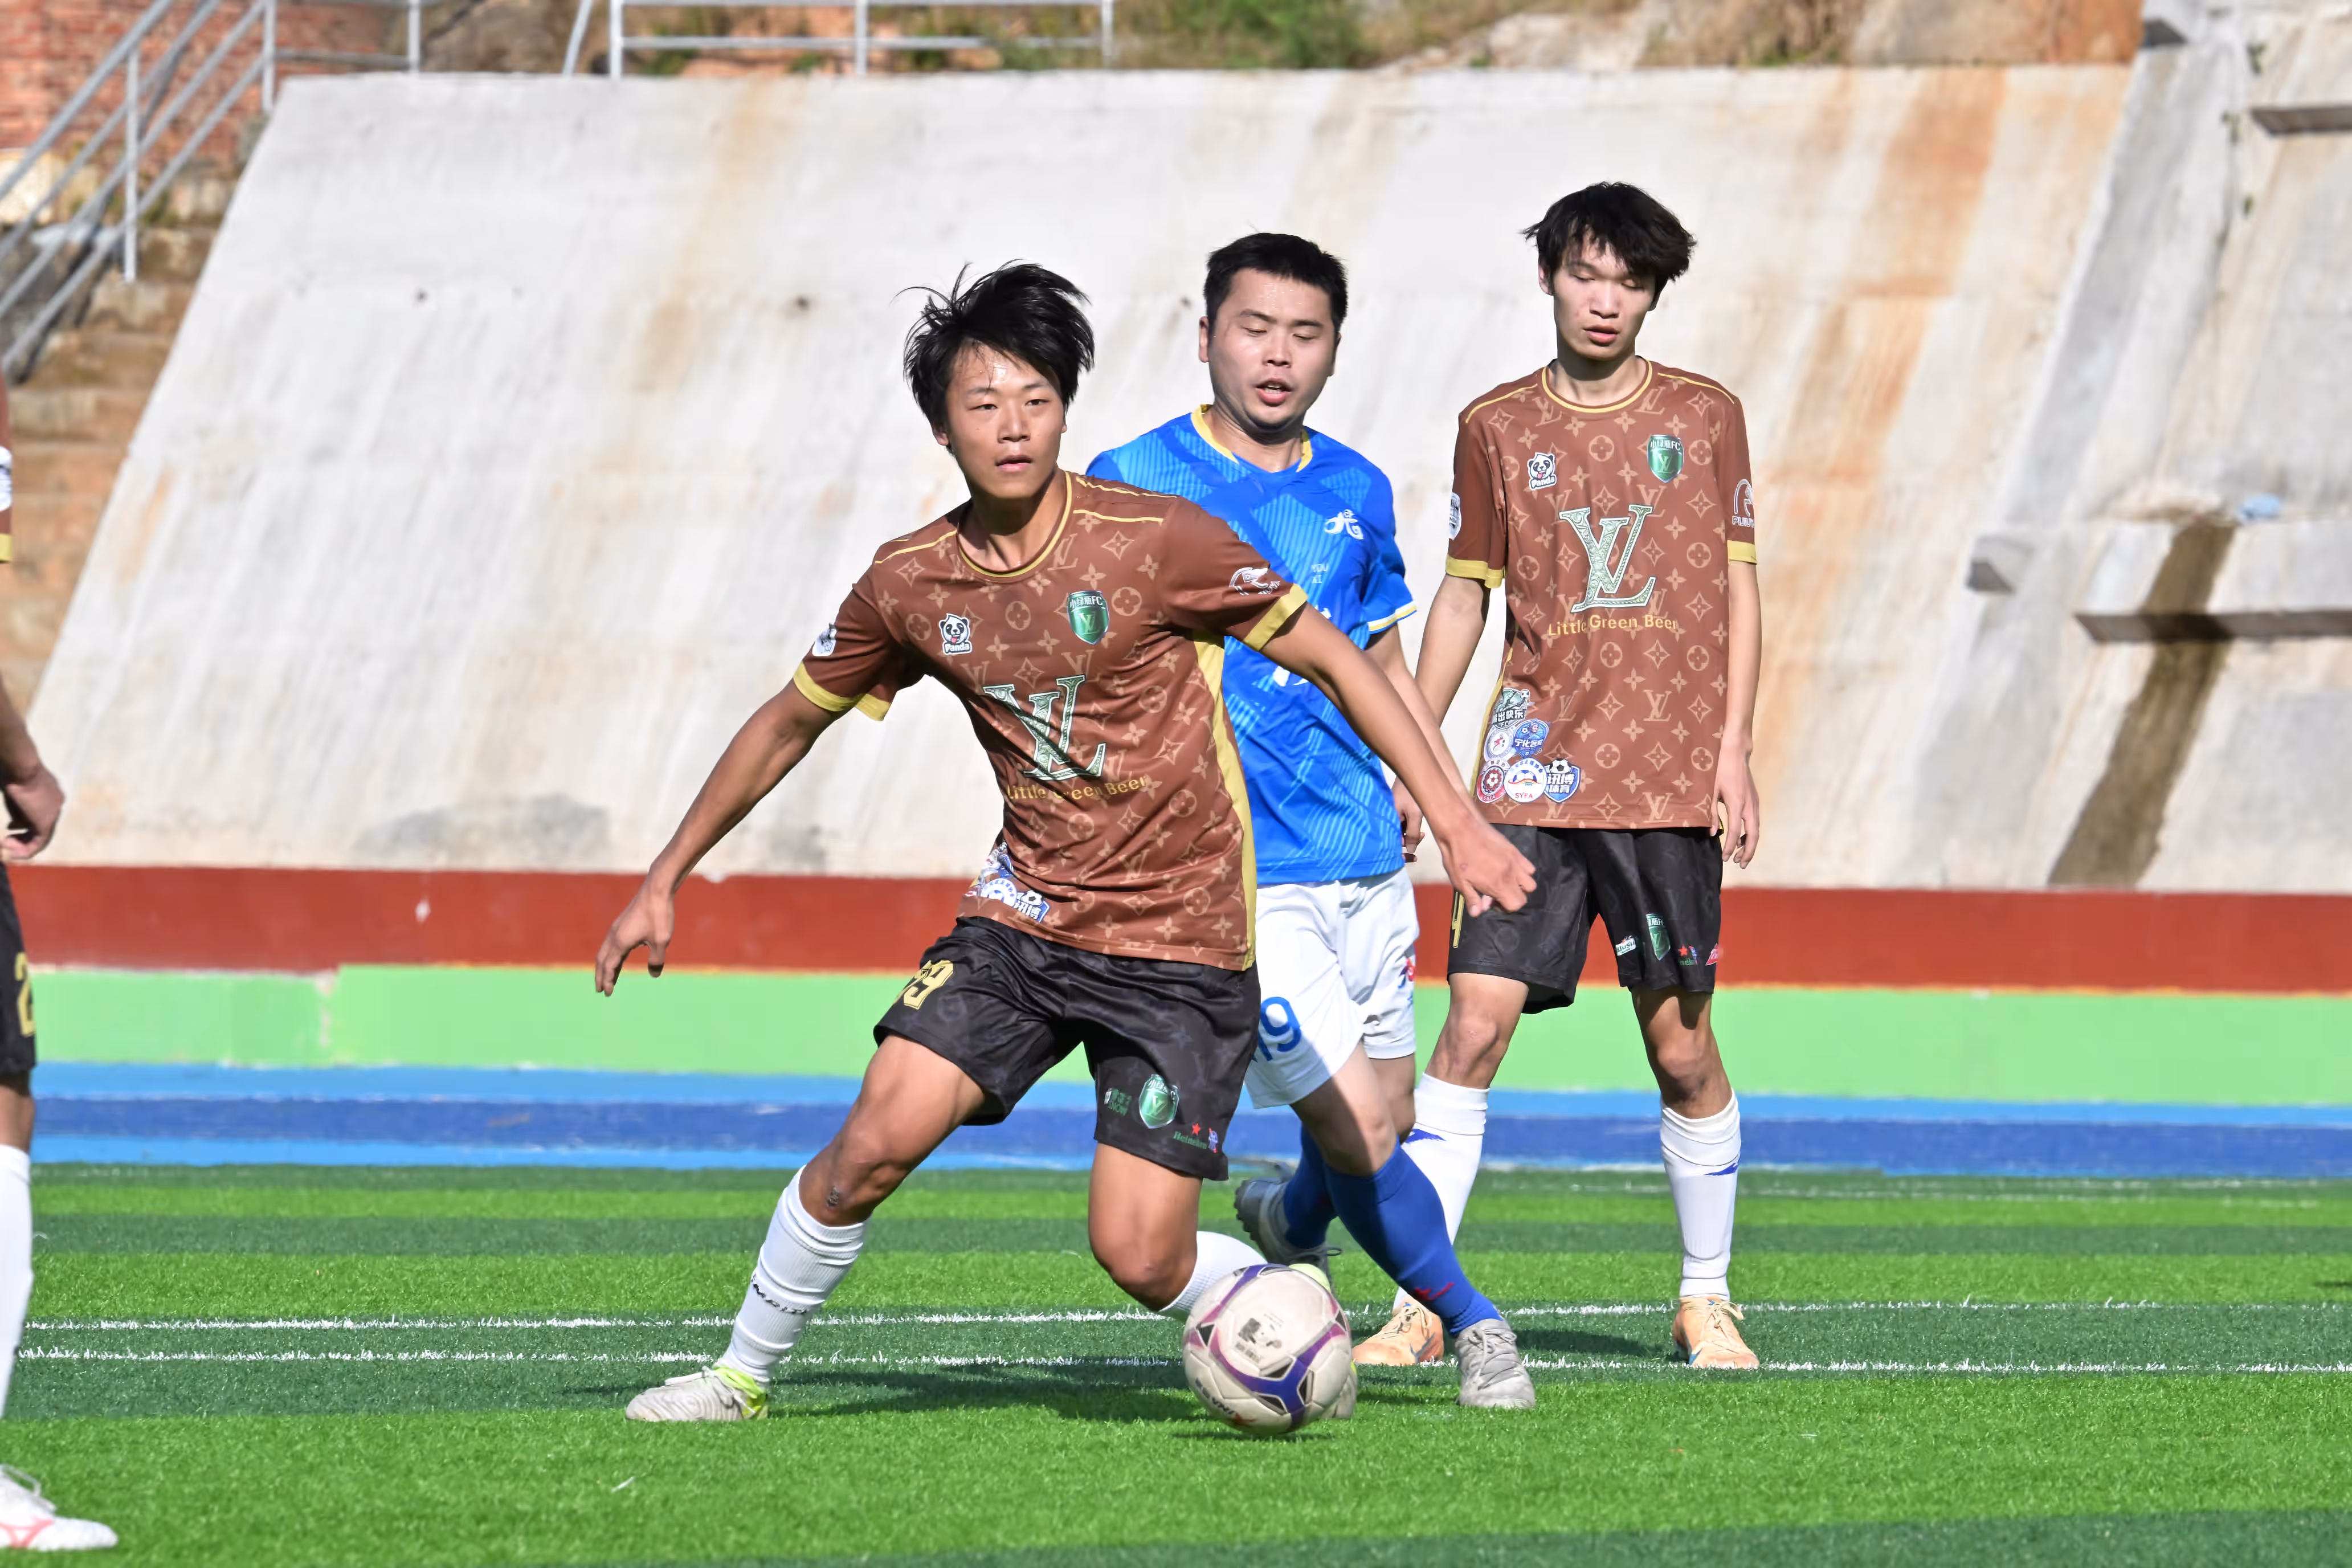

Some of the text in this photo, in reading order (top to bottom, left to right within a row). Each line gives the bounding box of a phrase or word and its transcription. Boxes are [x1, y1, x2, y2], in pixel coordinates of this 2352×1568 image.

[1548, 614, 1677, 636] Little Green Beer
[945, 642, 970, 652] Panda
[1547, 774, 1574, 785] 讯博
[1057, 785, 1104, 801] een
[1105, 775, 1148, 797] Beer
